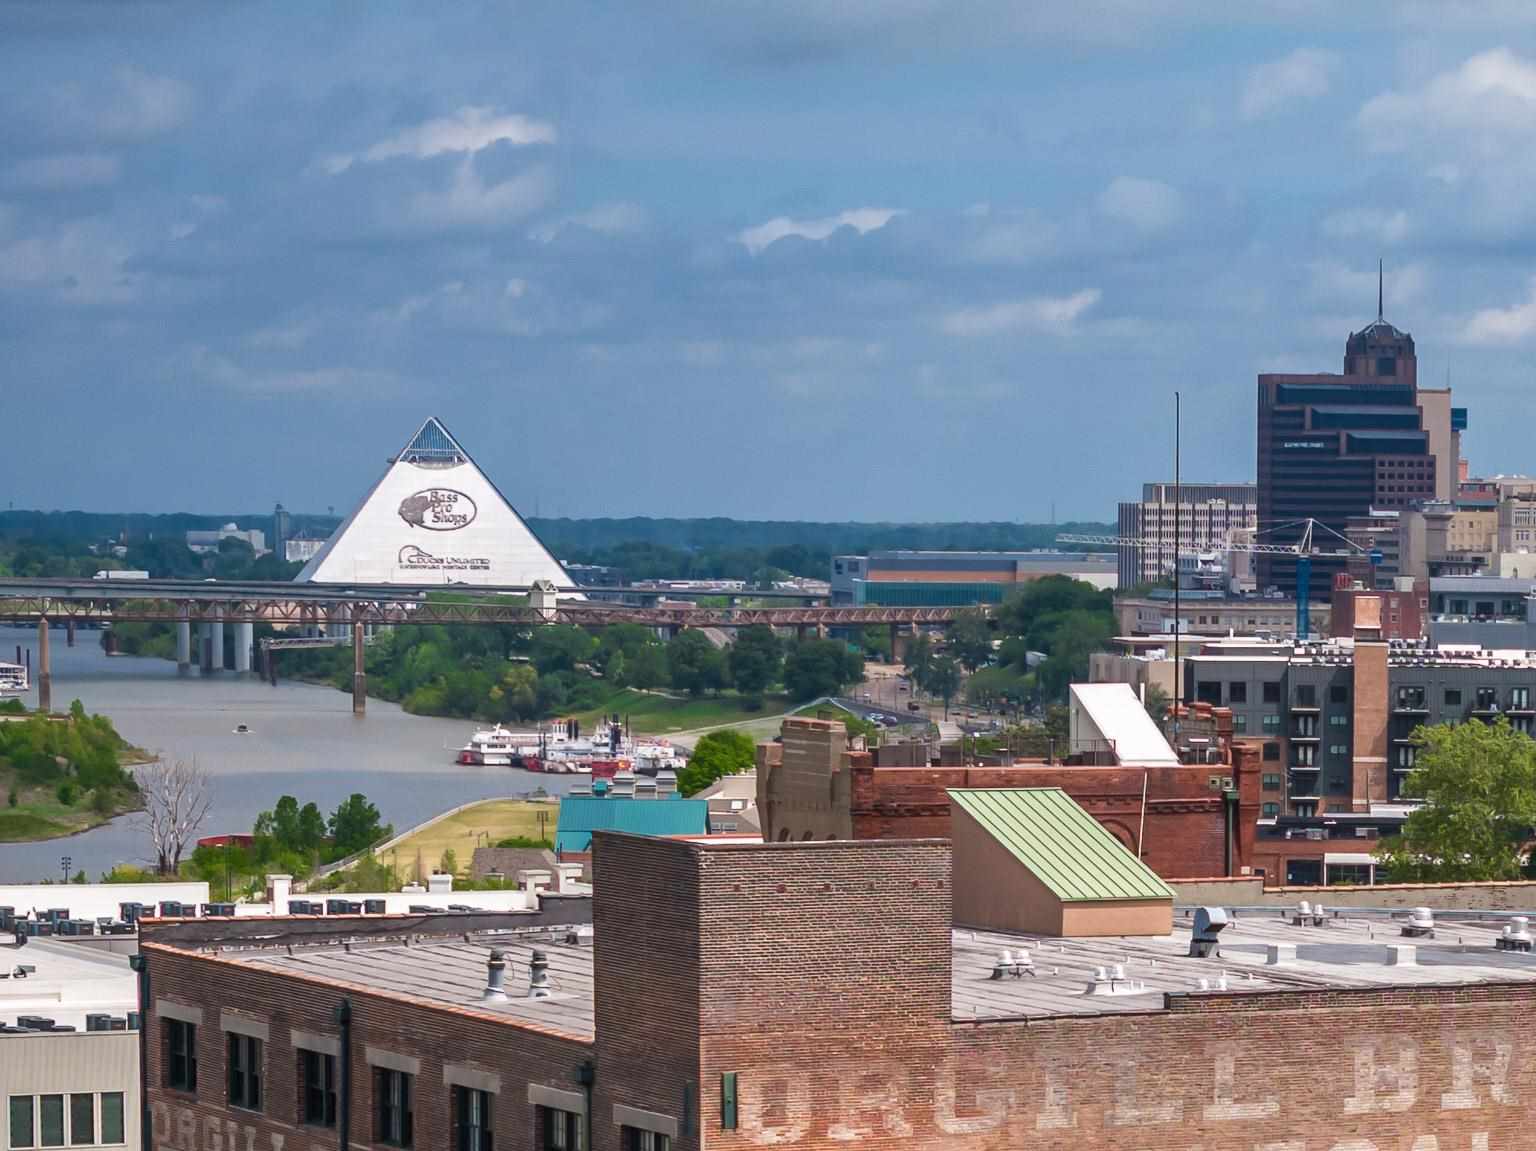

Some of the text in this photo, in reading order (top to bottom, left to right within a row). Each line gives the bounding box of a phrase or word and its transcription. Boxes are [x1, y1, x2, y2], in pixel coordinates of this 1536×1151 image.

[430, 491, 458, 503] Bass
[431, 502, 453, 513] Pro
[431, 511, 467, 525] Shops
[740, 1040, 1280, 1146] ORGILL
